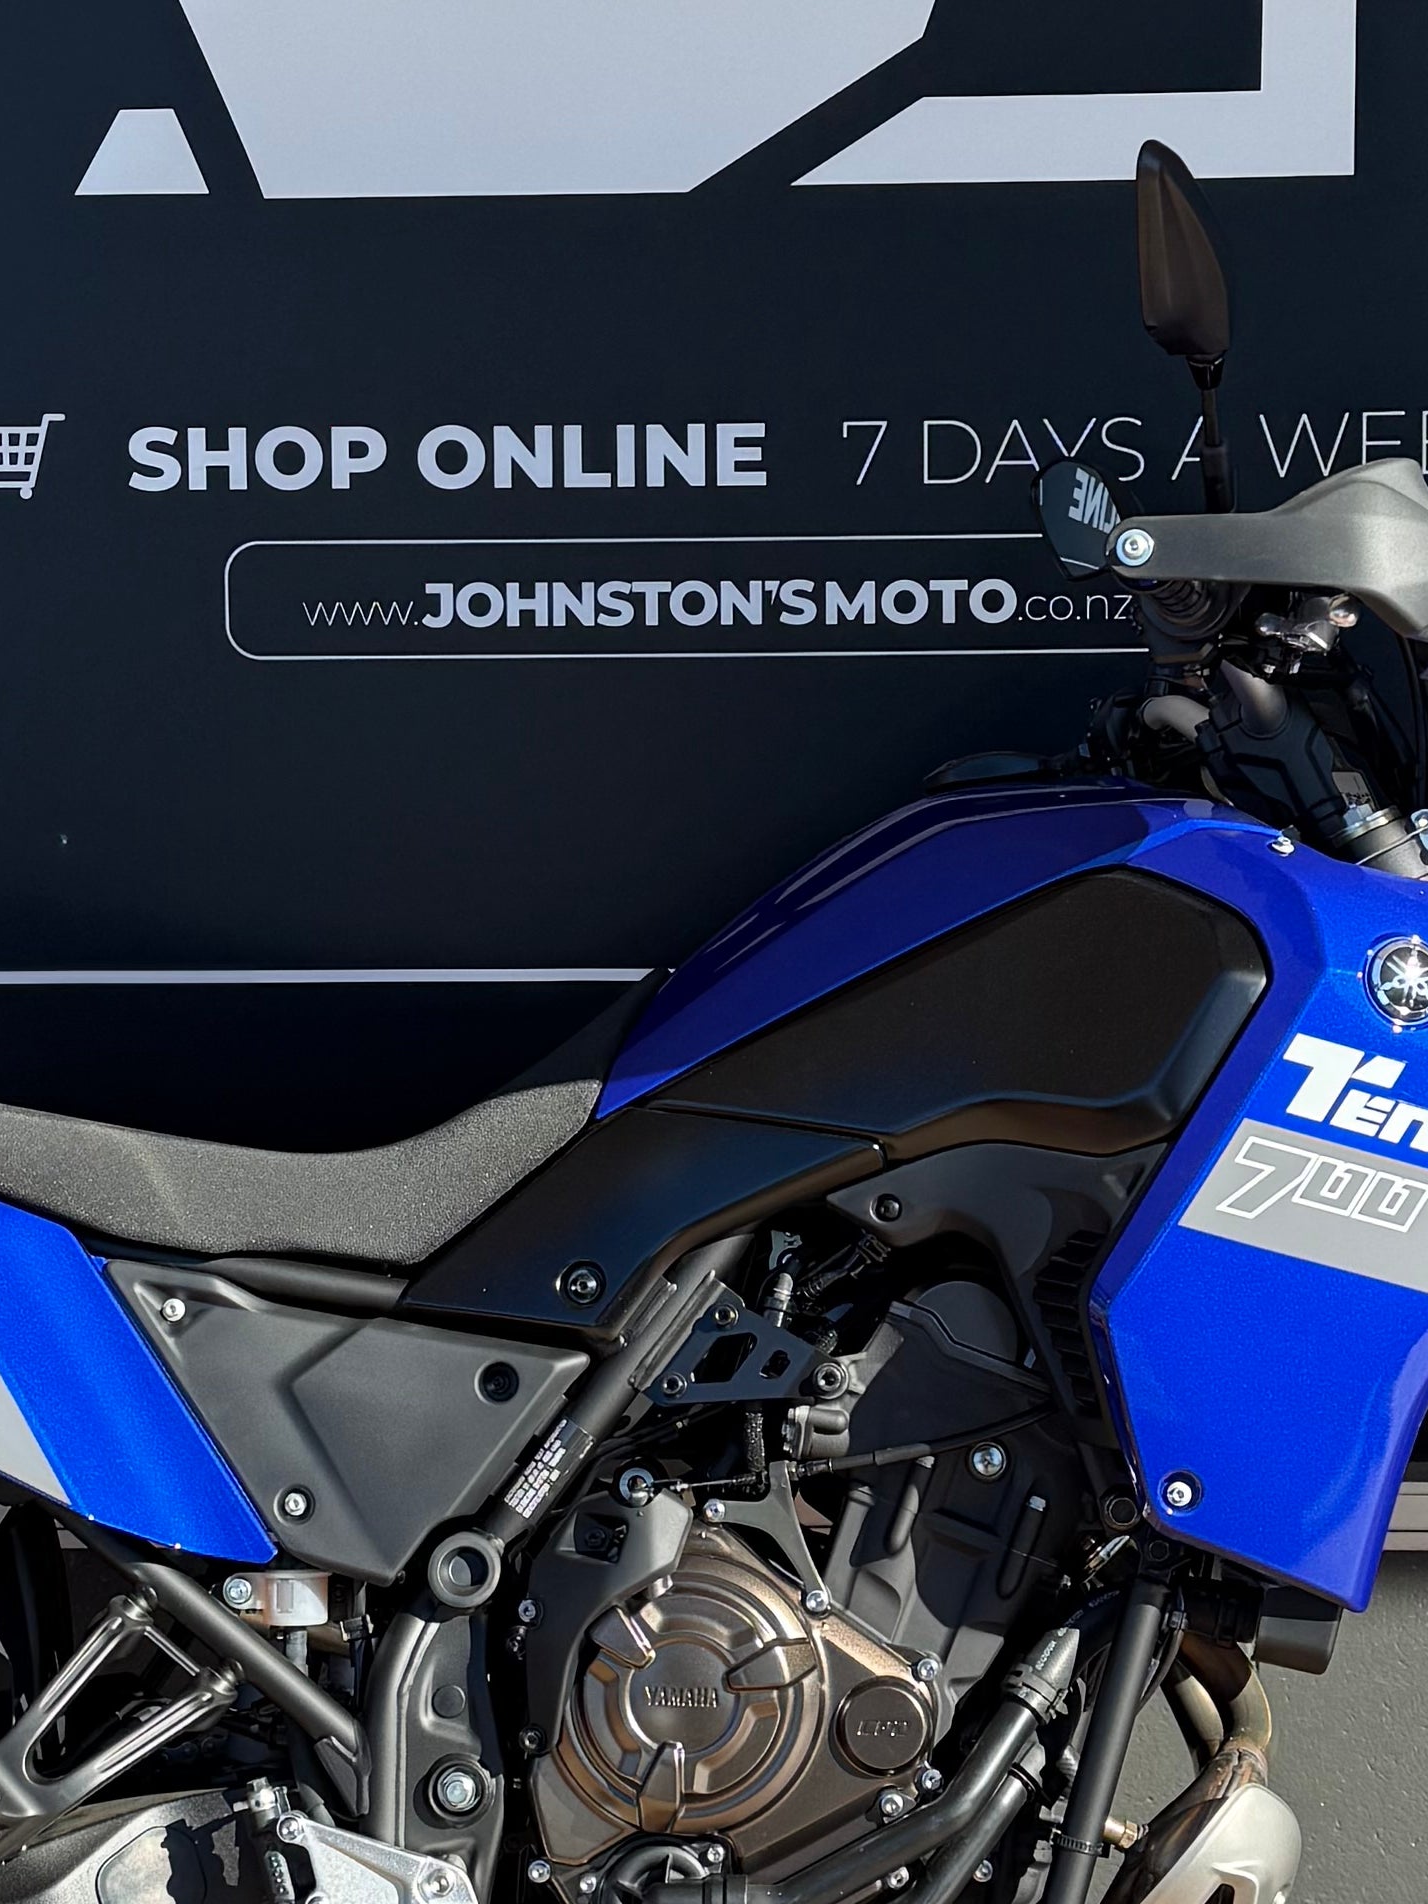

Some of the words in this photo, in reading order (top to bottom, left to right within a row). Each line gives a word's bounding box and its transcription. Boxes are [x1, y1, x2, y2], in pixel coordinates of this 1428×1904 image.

[129, 426, 388, 492] SHOP
[418, 423, 767, 490] ONLINE
[843, 421, 888, 486] 7
[924, 417, 1145, 485] DAYS
[643, 1684, 720, 1709] YAMAHA
